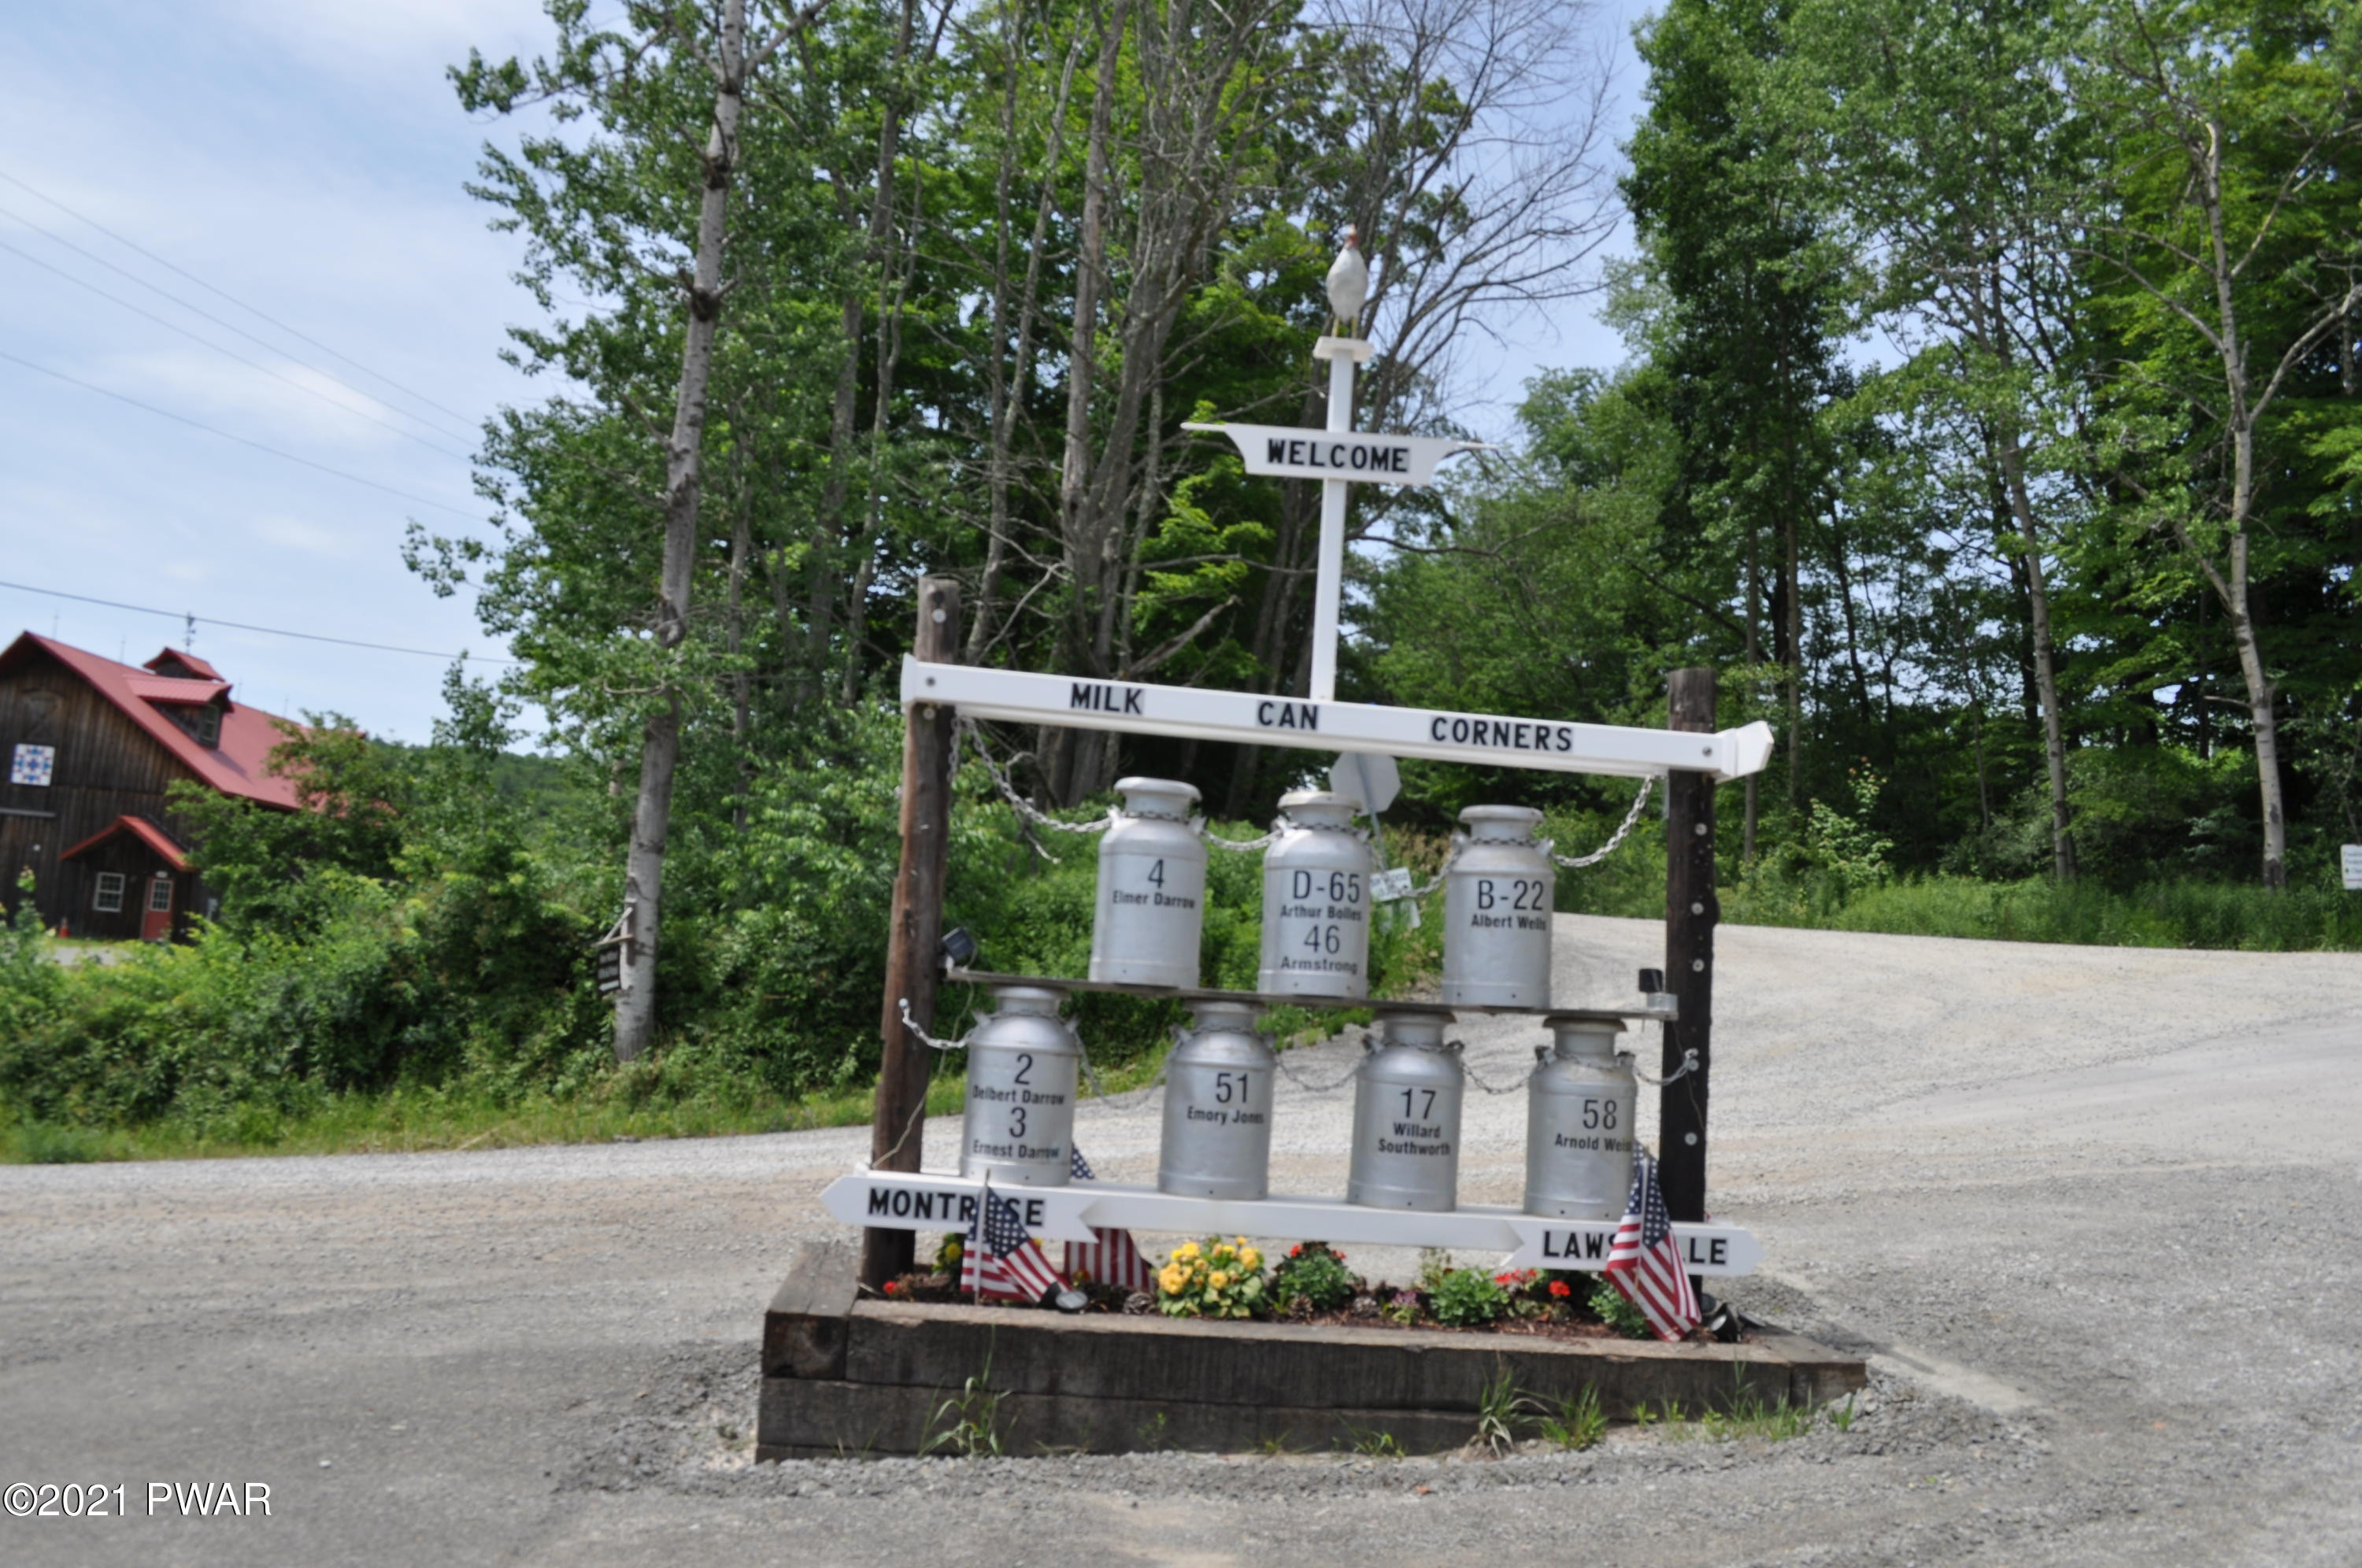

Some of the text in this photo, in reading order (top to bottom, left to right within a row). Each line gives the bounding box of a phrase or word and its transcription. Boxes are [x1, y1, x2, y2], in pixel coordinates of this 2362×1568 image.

[1268, 438, 1409, 472] WELCOME
[1070, 683, 1573, 752] MILK CAN CORNERS
[1147, 859, 1164, 889] 4
[1293, 870, 1361, 904] D-65
[1113, 890, 1195, 909] Elmer Darrow
[1478, 879, 1544, 911] B-22
[1280, 905, 1322, 919] Arthur
[1471, 914, 1547, 931] Albert Wells
[1304, 924, 1341, 955] 46
[1280, 956, 1358, 975] Armstrong
[1014, 1053, 1034, 1085] 2
[972, 1085, 1065, 1105] Delbert Darrow
[1215, 1072, 1248, 1104] 51
[1400, 1088, 1437, 1119] 17
[1009, 1107, 1027, 1138] 3
[1187, 1106, 1227, 1126] Emory
[1582, 1099, 1617, 1130] 58
[1393, 1122, 1442, 1139] Willard
[1554, 1133, 1599, 1151] Arnold
[972, 1140, 1061, 1159] Ernest Darrow
[1378, 1138, 1451, 1156] Southworth
[868, 1188, 1045, 1226] MONTRSE
[1542, 1230, 1727, 1266] LAWLE
